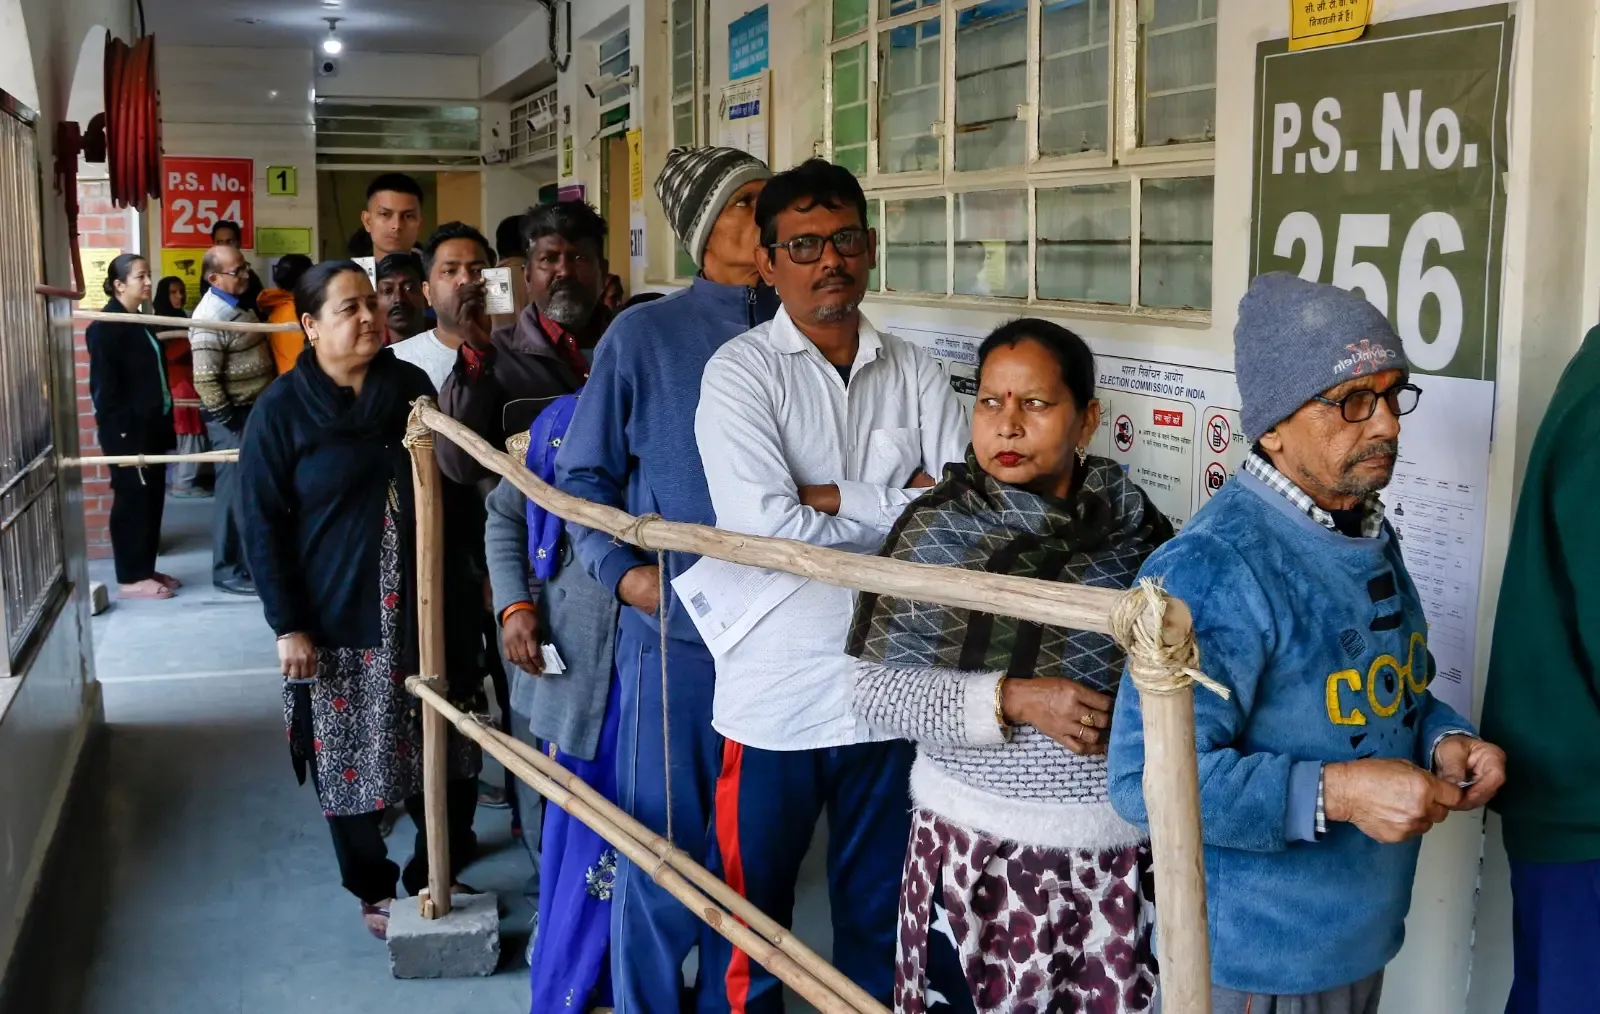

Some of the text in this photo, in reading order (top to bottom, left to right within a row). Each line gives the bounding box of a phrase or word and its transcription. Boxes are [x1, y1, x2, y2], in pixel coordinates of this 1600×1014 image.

[1272, 89, 1478, 174] P.S. No.
[168, 171, 246, 192] P.S. No.
[276, 170, 287, 191] 1
[630, 229, 643, 257] EXIT
[1121, 365, 1136, 376] भारत
[1100, 374, 1206, 400] ELECTION COMMISSION OF INDIA
